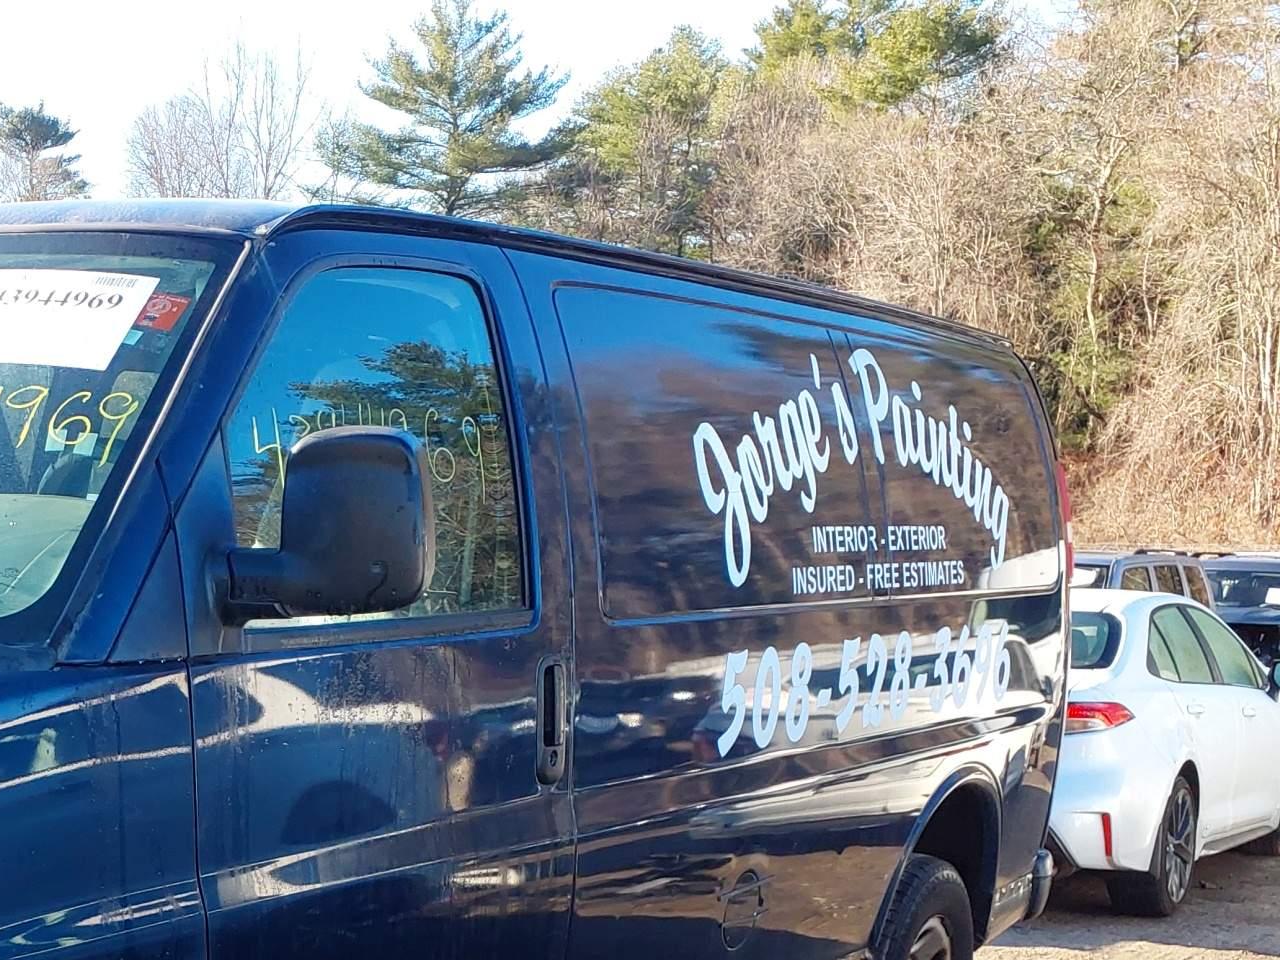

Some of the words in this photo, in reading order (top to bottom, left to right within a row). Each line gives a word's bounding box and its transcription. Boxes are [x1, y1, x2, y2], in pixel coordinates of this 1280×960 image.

[693, 353, 859, 588] Jorge's
[849, 348, 1010, 570] Painting
[793, 565, 855, 595] INSURED
[867, 563, 901, 591] FREE
[903, 560, 965, 589] ESTIMATES
[812, 526, 878, 554] INTERIOR
[888, 525, 947, 552] EXTERIOR
[717, 623, 1011, 758] 508-528-3696
